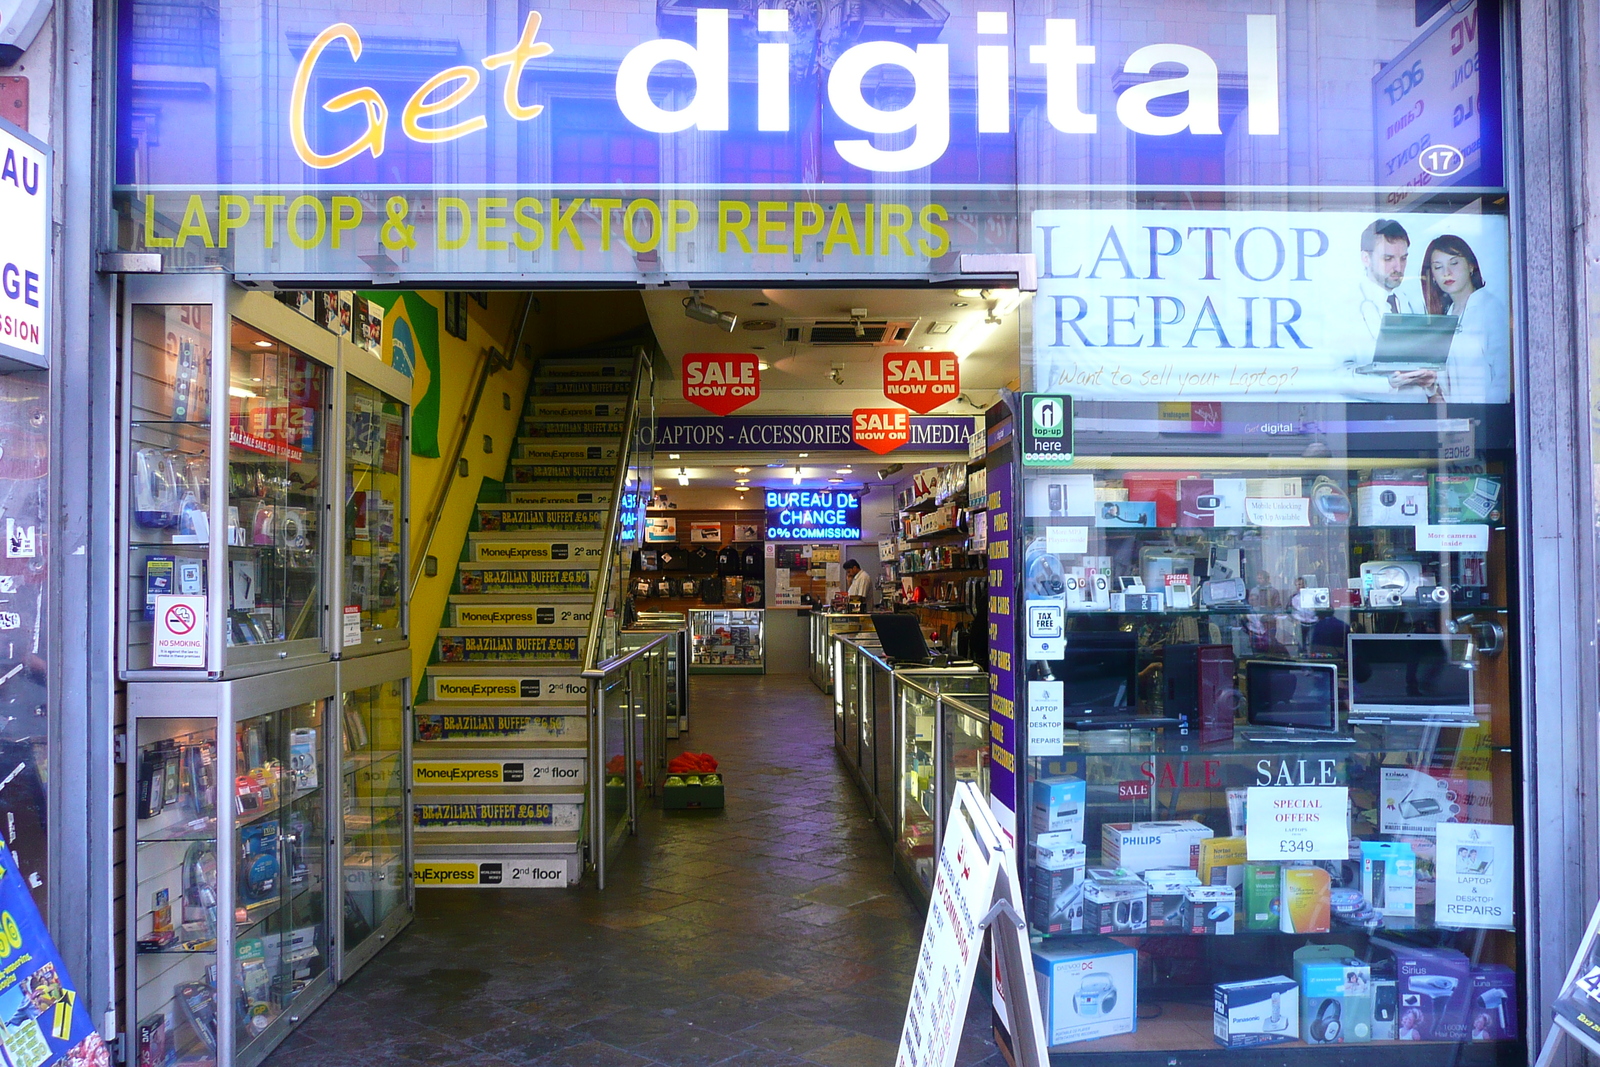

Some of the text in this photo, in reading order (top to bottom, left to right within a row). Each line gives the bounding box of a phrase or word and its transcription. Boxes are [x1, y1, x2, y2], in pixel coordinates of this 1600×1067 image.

[290, 8, 1280, 173] Get digital
[1428, 151, 1454, 171] 17
[2, 148, 39, 196] AU
[144, 194, 951, 259] LAPTOP & DESKTOP REPAIRS
[1036, 225, 1330, 282] LAPTOP
[3, 262, 40, 308] GE
[1047, 294, 1313, 350] REPAIR
[687, 362, 755, 385] SALE
[887, 360, 955, 381] SALE
[1058, 362, 1299, 396] Want to sell your Laptop?
[688, 387, 756, 396] NOW ON
[887, 384, 955, 394] NOW ON
[539, 408, 593, 417] MoneyExpress
[856, 414, 906, 431] SALE
[738, 425, 851, 444] ACCESSORIES
[910, 425, 970, 444] IMEDIA
[1034, 427, 1062, 436] top-up
[1260, 423, 1293, 435] digital
[230, 431, 242, 443] SALE
[243, 434, 254, 447] SALE
[255, 439, 266, 451] SALE
[291, 449, 302, 460] SALE
[1034, 438, 1062, 451] here
[528, 450, 584, 460] MoneyExpress
[533, 466, 597, 477] BRAZILIAN BUFFET
[767, 492, 858, 508] BUREAU DE
[1251, 502, 1302, 512] Mobile Unlocking
[502, 511, 544, 523] BRAZILIAN
[547, 511, 574, 523] BUFFET
[780, 509, 847, 525] CHANGE
[1254, 513, 1264, 521] Top
[1265, 513, 1274, 521] Up
[767, 527, 860, 538] 0% COMMISSION
[481, 548, 548, 559] MoneyExpress
[484, 571, 587, 583] BRAZILIAN BUFFET £6.50
[461, 612, 533, 623] MoneyExpress
[1038, 612, 1052, 620] TAX
[1036, 620, 1054, 628] FREE
[465, 638, 576, 651] BRAZILIAN BUFFET £6.50
[440, 684, 517, 696] MoneyExpress
[548, 683, 564, 694] 2nd
[444, 716, 531, 730] BRAZILIAN BUFFET
[417, 767, 579, 781] MoneyExpress 2nd floor
[1140, 760, 1222, 788] SALE
[1256, 759, 1337, 787] SALE
[1119, 784, 1148, 796] SALE
[1273, 799, 1323, 809] SPECIAL
[422, 804, 550, 819] BRAZILIAN BUFFET £6.50
[1275, 813, 1320, 822] OFFERS
[1122, 836, 1161, 846] PHILIPS
[1280, 839, 1314, 853] £349
[512, 867, 530, 880] 2nd
[532, 867, 562, 879] floor
[1457, 877, 1492, 885] LAPTOP
[1455, 895, 1494, 903] DESKTOP
[1447, 904, 1502, 916] REPAIRS
[944, 888, 969, 967] COMMISSION
[240, 945, 252, 955] GP
[1402, 966, 1427, 975] Sirius
[253, 1005, 266, 1015] GP
[1232, 1015, 1260, 1023] Panasonic
